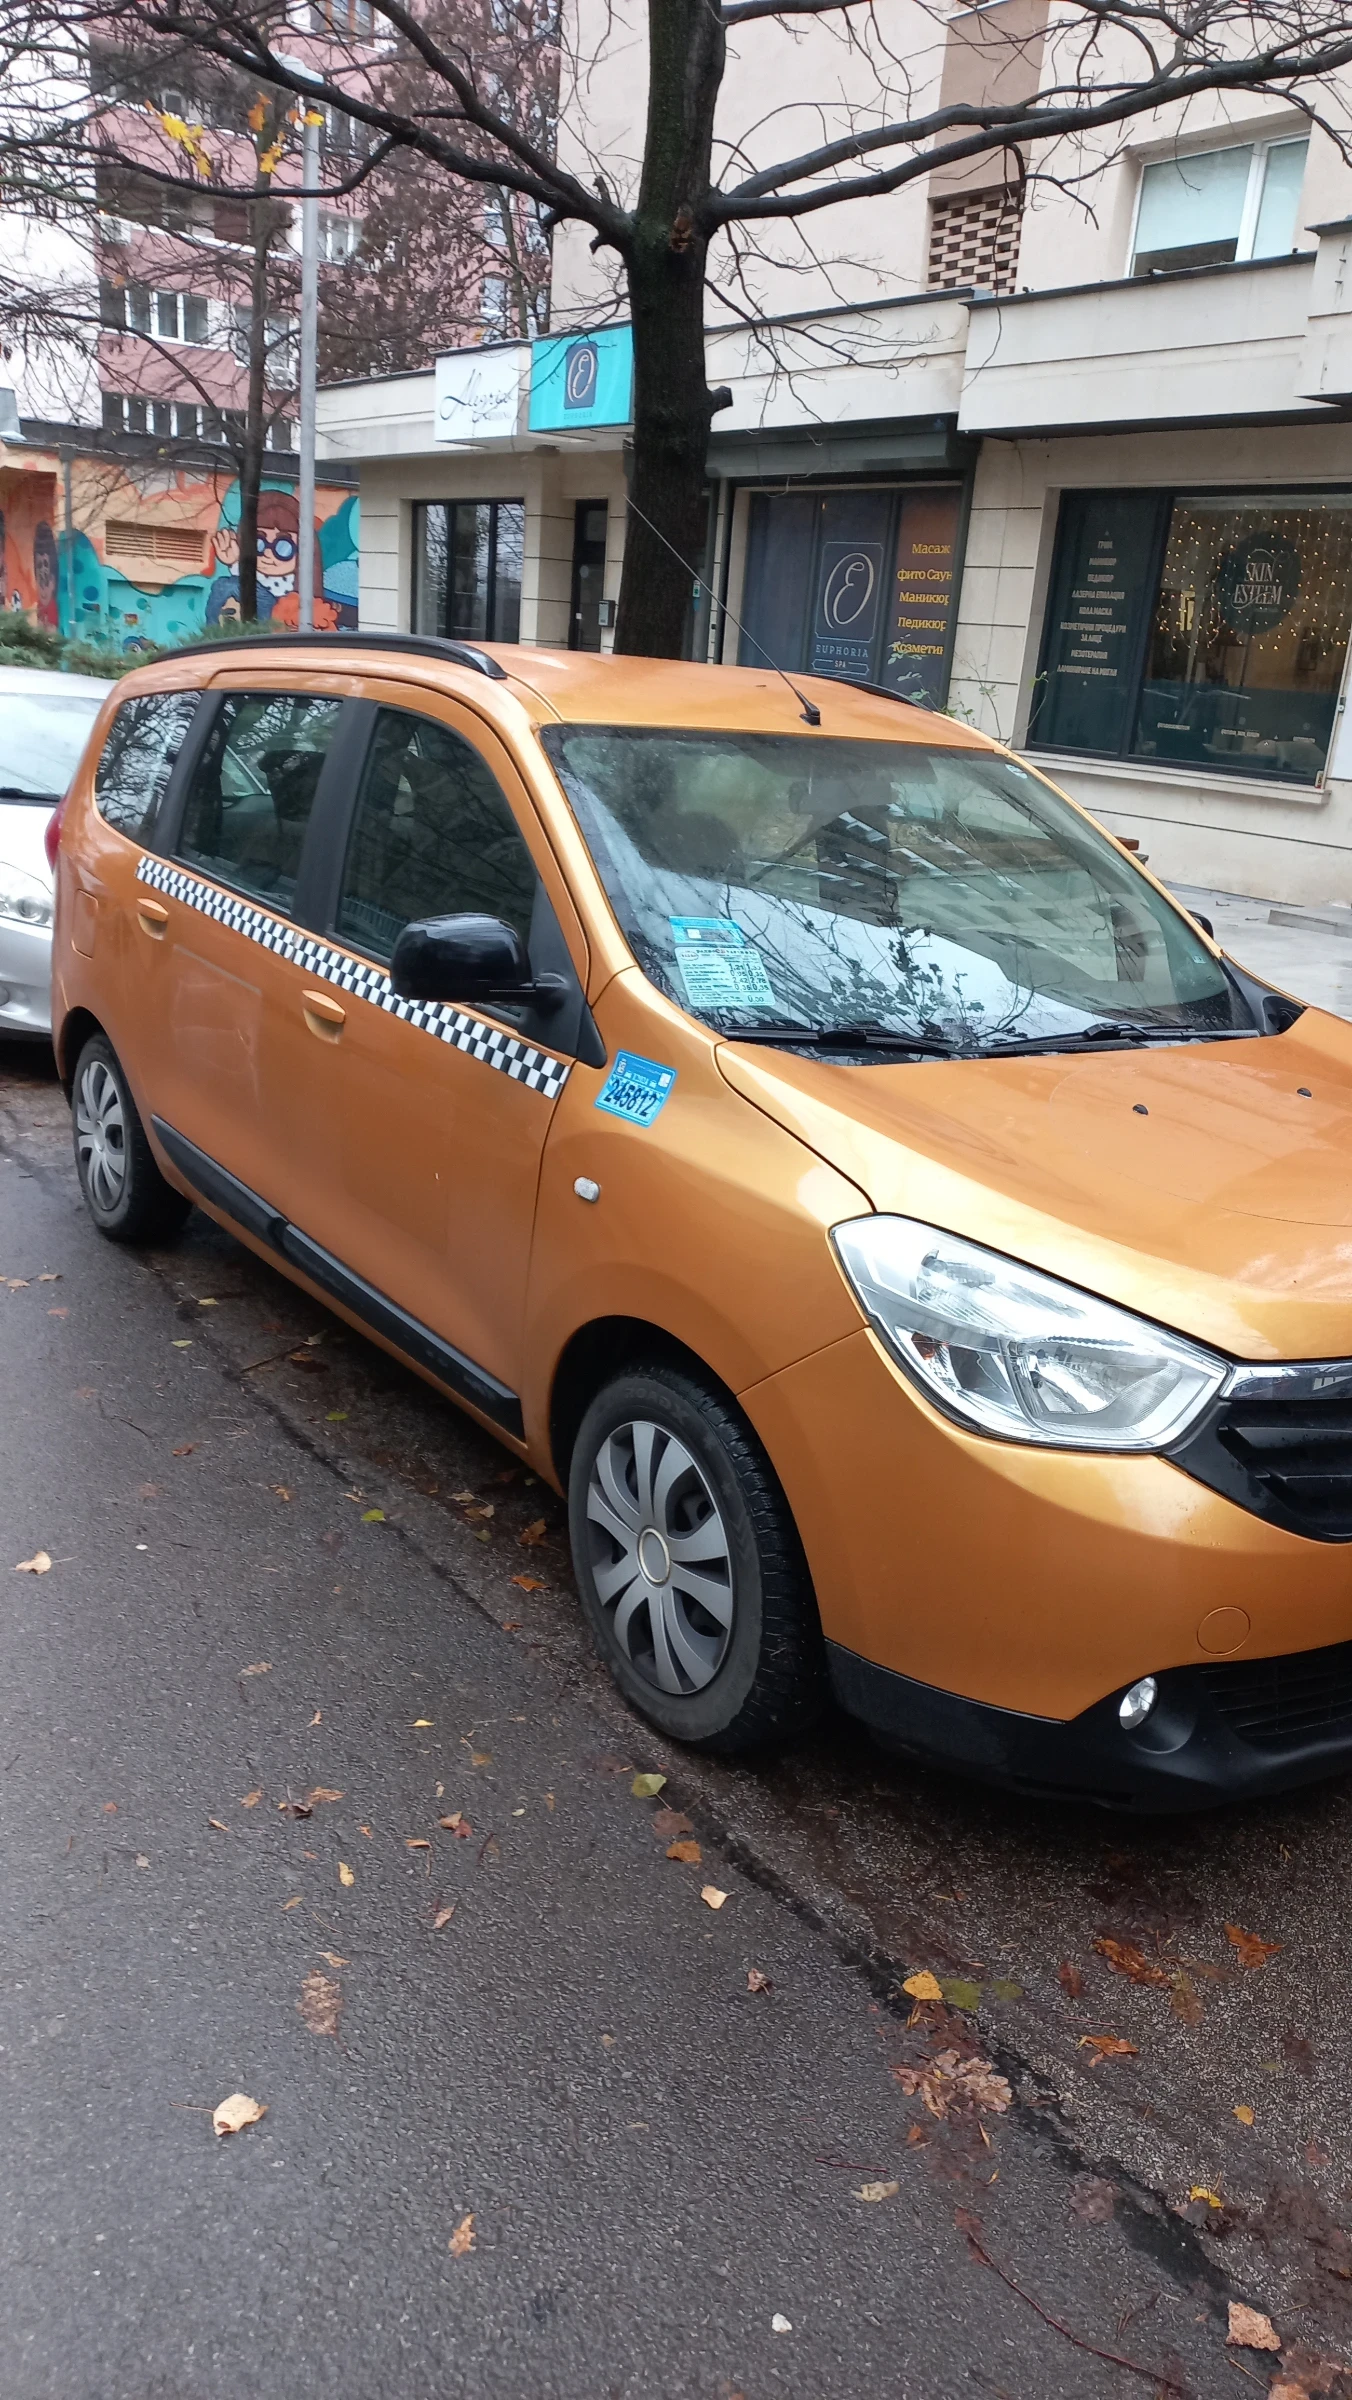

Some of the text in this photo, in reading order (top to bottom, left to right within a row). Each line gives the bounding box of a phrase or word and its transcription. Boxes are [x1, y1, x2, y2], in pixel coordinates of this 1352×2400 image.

[912, 543, 951, 554] Масаж
[897, 568, 926, 582] фито
[1244, 562, 1274, 582] SKIN
[899, 592, 950, 606] Маникюр
[1232, 583, 1283, 606] ESTEEM
[897, 616, 948, 632] Педикюр
[815, 644, 869, 658] EUPHORIA
[834, 660, 846, 668] SPA
[603, 1078, 658, 1117] 245812
